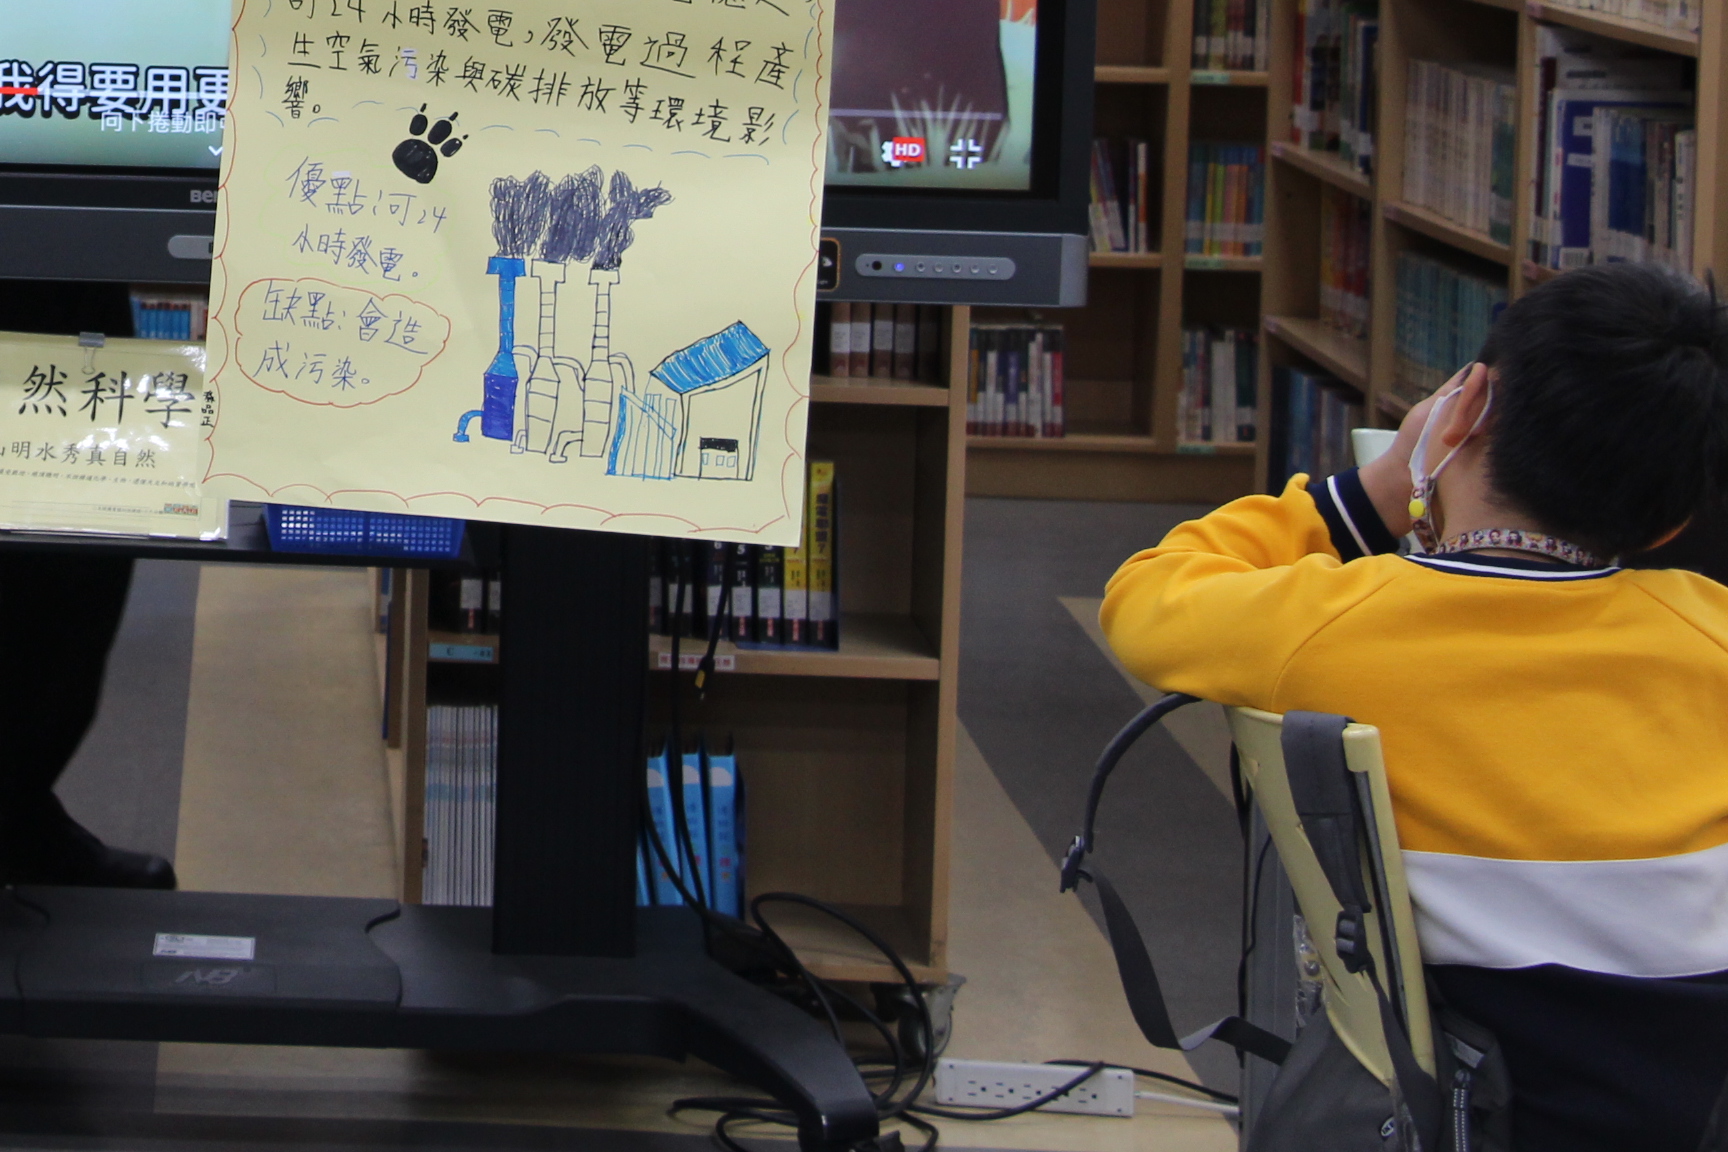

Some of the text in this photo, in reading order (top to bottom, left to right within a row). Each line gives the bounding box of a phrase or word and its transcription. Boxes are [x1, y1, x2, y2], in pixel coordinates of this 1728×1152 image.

[100, 109, 227, 134] 向下捲動即
[894, 142, 922, 158] HD
